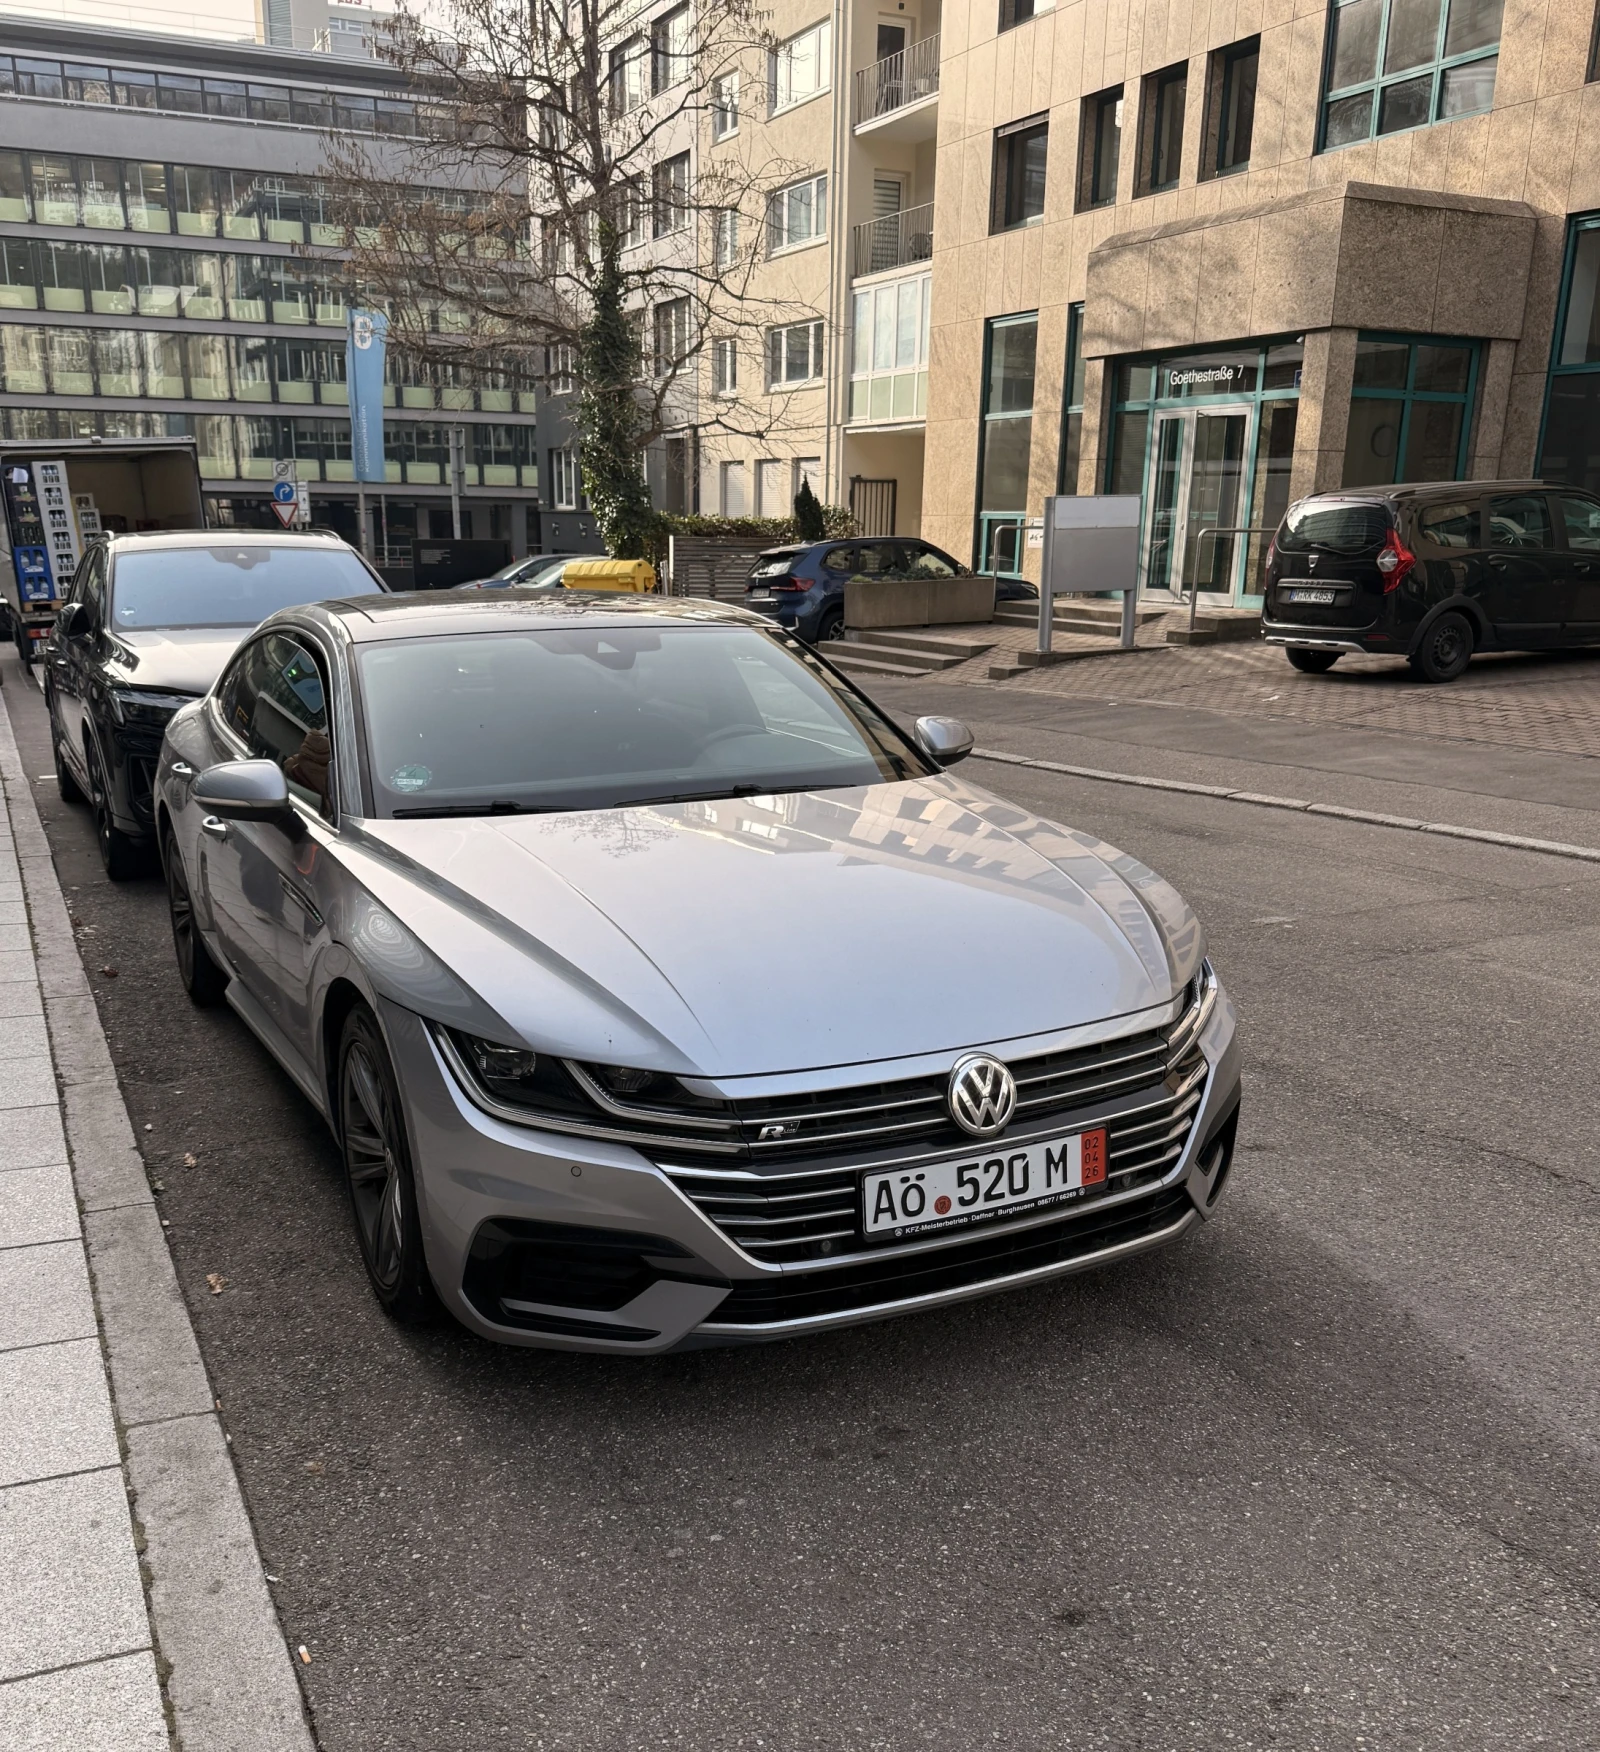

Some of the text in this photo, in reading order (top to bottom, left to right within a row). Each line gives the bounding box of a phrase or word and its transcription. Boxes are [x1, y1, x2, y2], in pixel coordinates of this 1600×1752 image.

[1170, 364, 1244, 385] Goethestraße 7
[1085, 1136, 1099, 1150] 02
[1085, 1151, 1099, 1164] 04
[1085, 1165, 1099, 1179] 26
[872, 1143, 1069, 1224] AÖ 520 M
[905, 1216, 968, 1234] KFZ-Meisterbetrieb
[998, 1202, 1035, 1216] Burghausen
